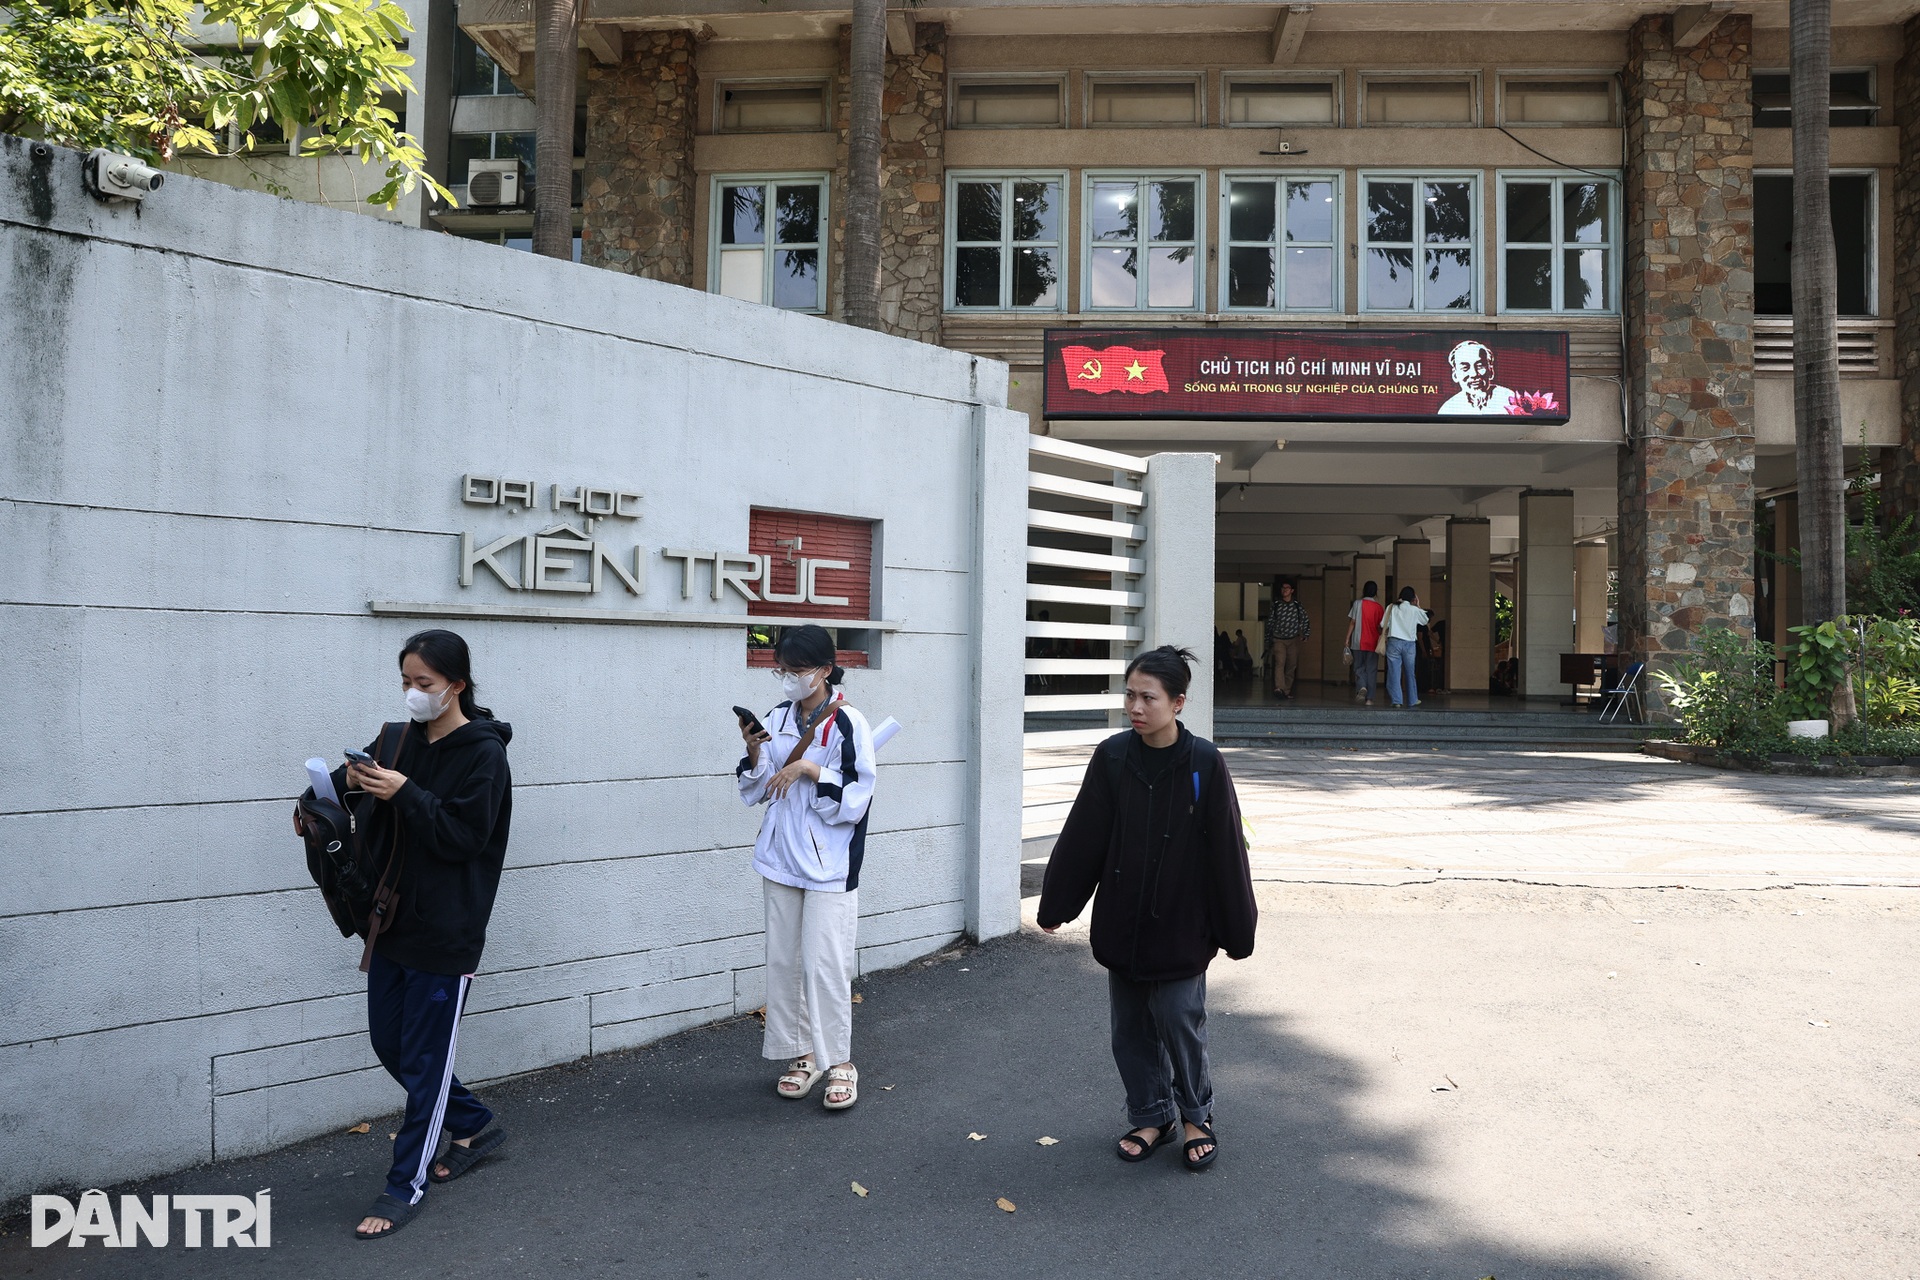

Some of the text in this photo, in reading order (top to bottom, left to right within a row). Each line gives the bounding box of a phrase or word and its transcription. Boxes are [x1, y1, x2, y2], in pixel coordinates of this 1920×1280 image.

[1200, 356, 1421, 379] CHỦ TỊCH HỒ CHÍ MINH VĨ ĐẠI
[1184, 381, 1438, 396] SỐNG MÃI TRONG SỰ NGHIỆP CỦA CHÚNG TA!
[462, 474, 644, 522] ĐẠI HỌC
[459, 517, 850, 606] KIẾN TRÚC
